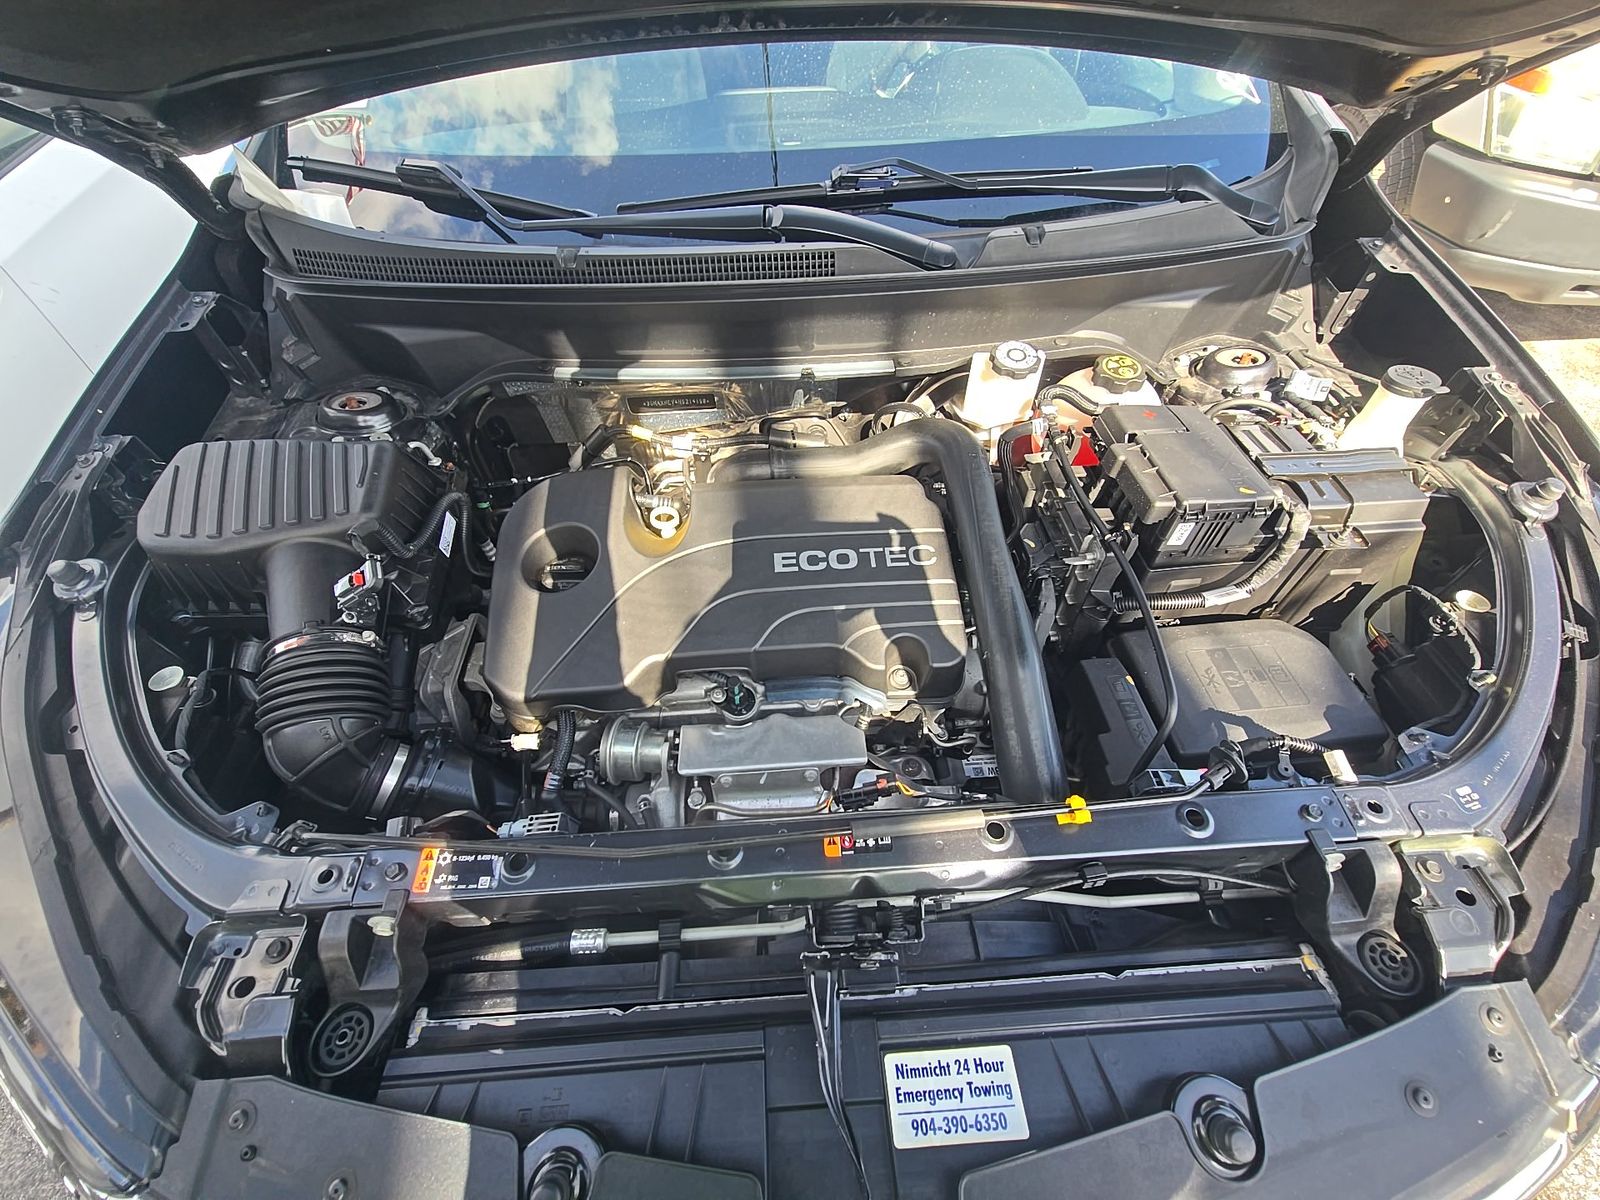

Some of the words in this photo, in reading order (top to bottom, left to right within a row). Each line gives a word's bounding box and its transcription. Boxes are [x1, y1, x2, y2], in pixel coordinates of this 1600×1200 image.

[773, 544, 937, 573] ECOTEC
[894, 1059, 951, 1080] Nimnicht
[954, 1058, 970, 1075] 24
[973, 1057, 1005, 1074] Hour
[895, 1085, 964, 1106] Emergency
[966, 1081, 1013, 1101] Towing
[911, 1112, 1008, 1137] 904-390-6350
